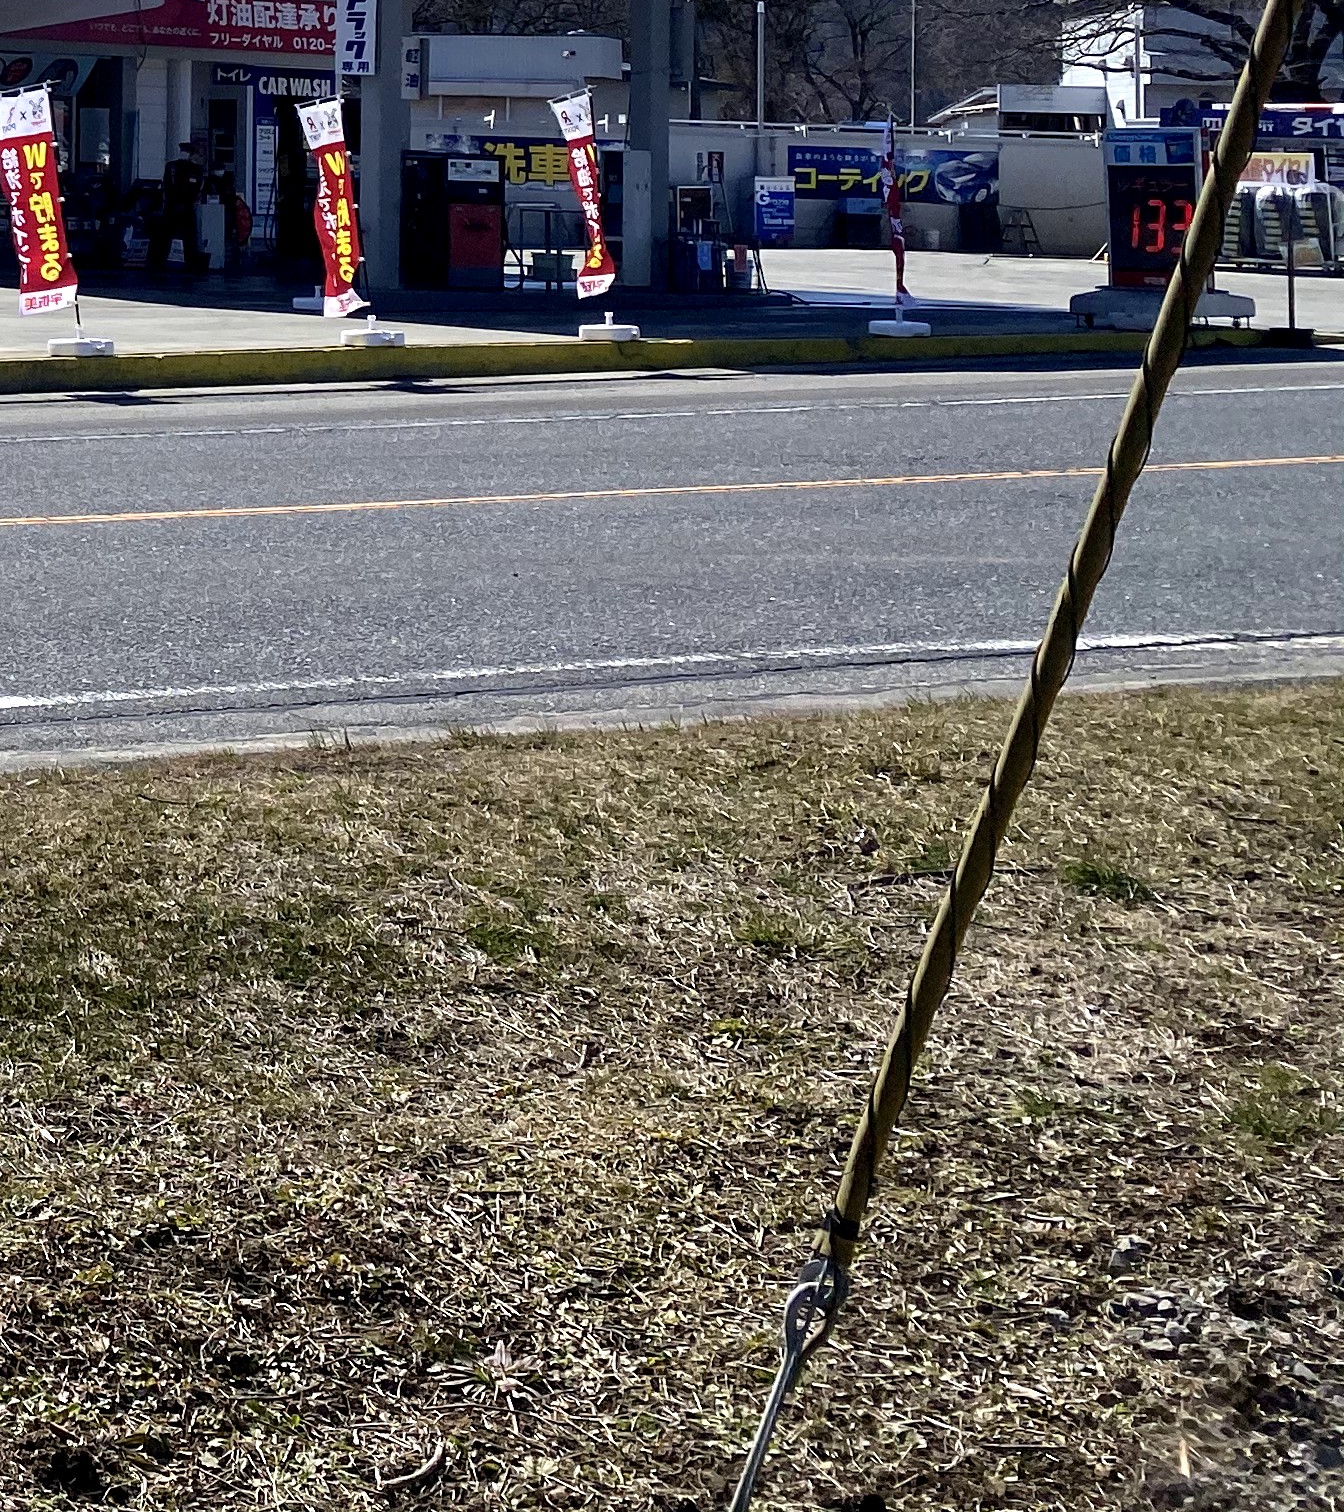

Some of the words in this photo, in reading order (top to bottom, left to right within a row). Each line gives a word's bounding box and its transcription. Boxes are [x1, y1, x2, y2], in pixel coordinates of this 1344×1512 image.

[209, 33, 284, 49] フリーダイヤル
[216, 68, 252, 82] トイレ
[342, 61, 369, 73] 専用
[258, 76, 289, 95] CAR
[289, 78, 331, 97] WASH
[483, 142, 570, 187] 洗車
[793, 167, 931, 193] コーティグ
